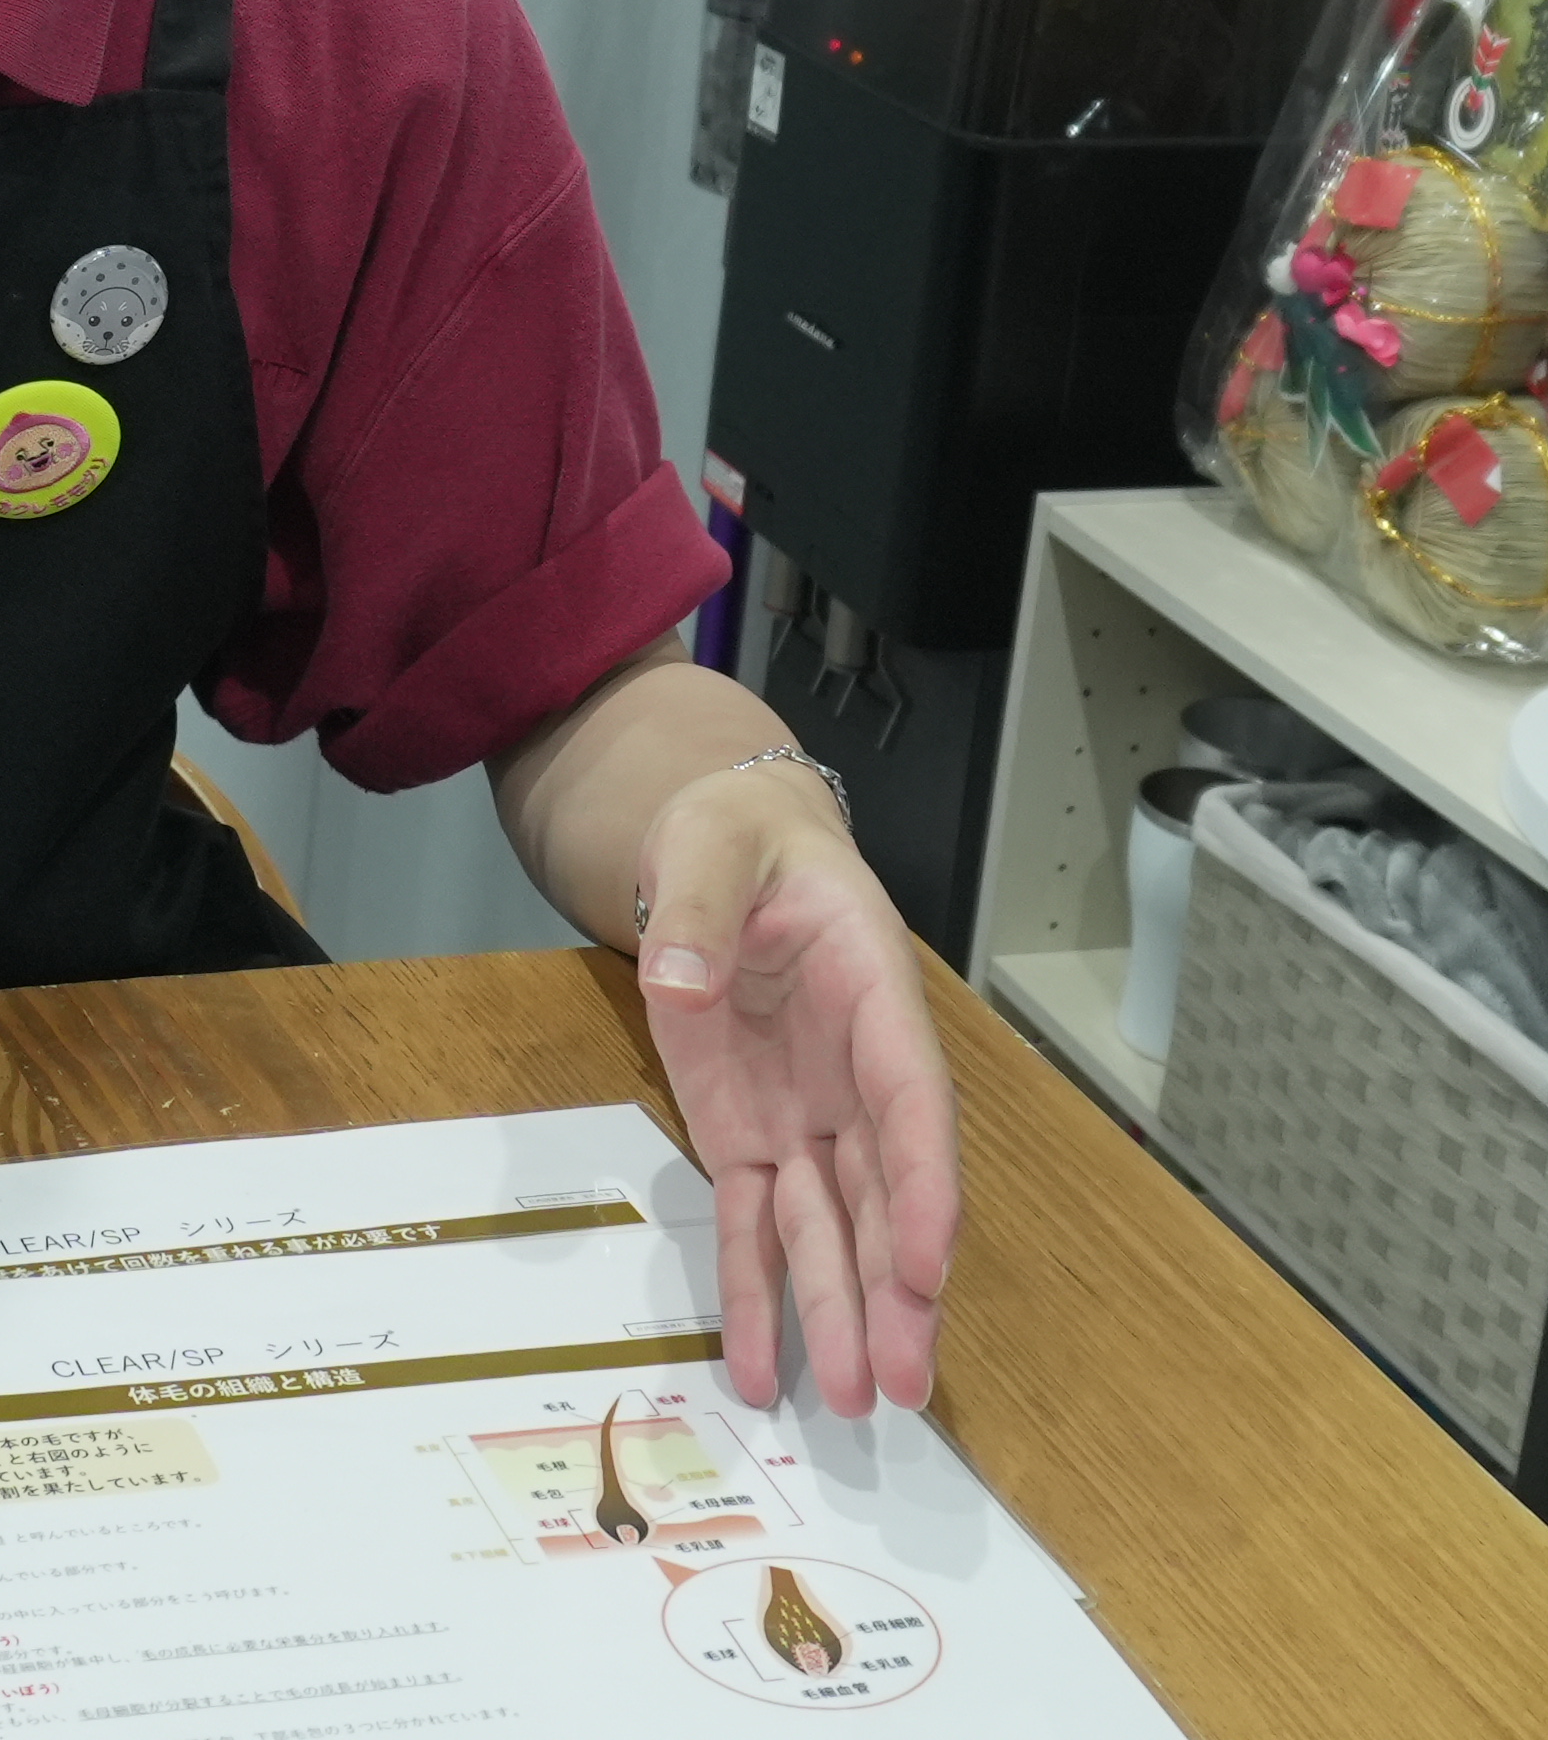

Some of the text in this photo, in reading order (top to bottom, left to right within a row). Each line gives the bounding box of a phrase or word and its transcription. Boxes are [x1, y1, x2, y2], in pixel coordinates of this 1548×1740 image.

[179, 1207, 308, 1237] シリーズ
[51, 1329, 402, 1379] CLEAR/SP シリーズ
[127, 1367, 366, 1406] 体毛の組織と構造
